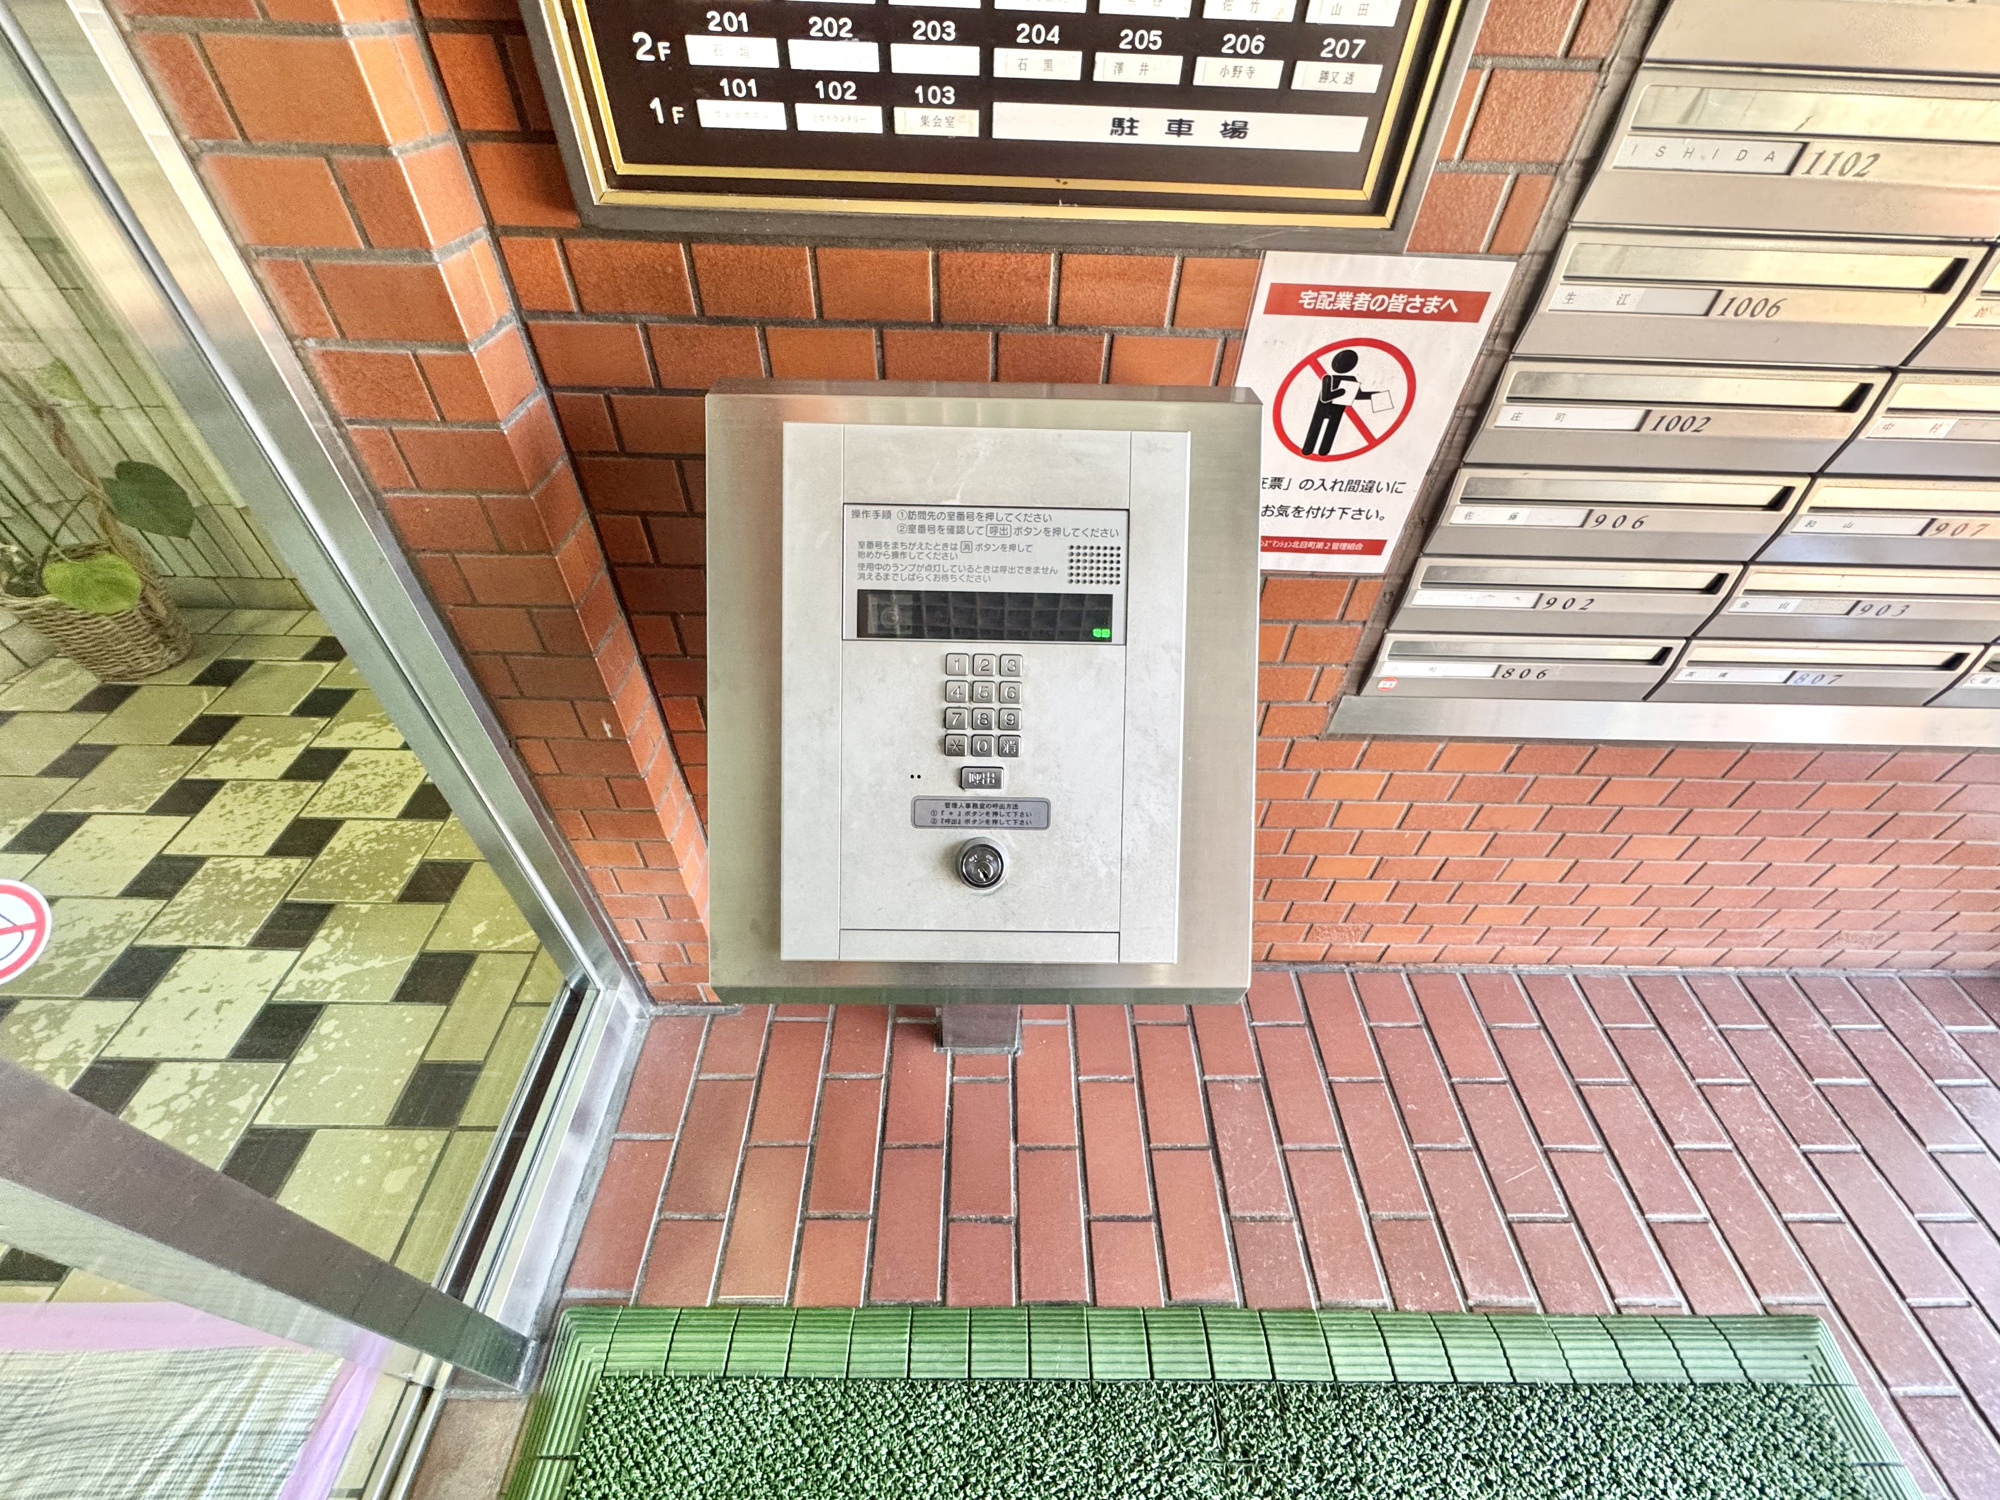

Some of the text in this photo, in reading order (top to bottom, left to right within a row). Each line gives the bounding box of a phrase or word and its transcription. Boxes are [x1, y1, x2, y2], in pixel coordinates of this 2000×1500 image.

[1330, 3, 1370, 17] 山田
[706, 11, 748, 33] 201
[808, 17, 853, 38] 202
[912, 20, 956, 41] 203
[1016, 23, 1060, 45] 204
[632, 31, 671, 62] 2F
[1119, 30, 1163, 51] 205
[1221, 34, 1265, 55] 206
[1320, 38, 1366, 59] 207
[1017, 58, 1054, 73] 石黒
[1219, 64, 1256, 80] 小野寺
[720, 78, 758, 98] 101
[815, 80, 857, 100] 102
[916, 85, 956, 105] 103
[649, 98, 684, 125] 1F
[920, 114, 955, 129] 集会室
[1109, 116, 1250, 140] 駐車場
[1630, 144, 1776, 163] ISHIDA
[1801, 150, 1881, 178] 1102
[1298, 290, 1459, 314] 宅配業者の皆さまへ
[1718, 296, 1788, 318] 1006
[1510, 411, 1566, 424] 庄司
[1649, 414, 1712, 433] 1002
[851, 509, 1053, 523] 操作手順 ①訪問先の室番号を押してください
[1261, 504, 1386, 522] お気を付け下さい。
[1590, 514, 1649, 530] 906
[1932, 522, 1990, 538] 907
[857, 551, 959, 561] 始めから操作してください
[857, 563, 1059, 576] 使用中のランプが点灯しているときは呼出できません
[856, 572, 992, 584] 消えるまでしばらくお待ちください
[1542, 597, 1595, 611] 902
[1859, 603, 1911, 618] 903
[954, 658, 960, 672] 1
[980, 658, 990, 672] 2
[1006, 659, 1017, 672] 3
[1501, 668, 1551, 681] 806
[1793, 672, 1843, 686] 807
[951, 685, 962, 699] 4
[978, 686, 990, 699] 5
[1006, 687, 1016, 700] 6
[952, 712, 962, 725] 7
[978, 713, 989, 725] 8
[1005, 713, 1016, 726] 9
[977, 740, 988, 752] 0
[944, 802, 1019, 810] 管理人事務室の呼出方法
